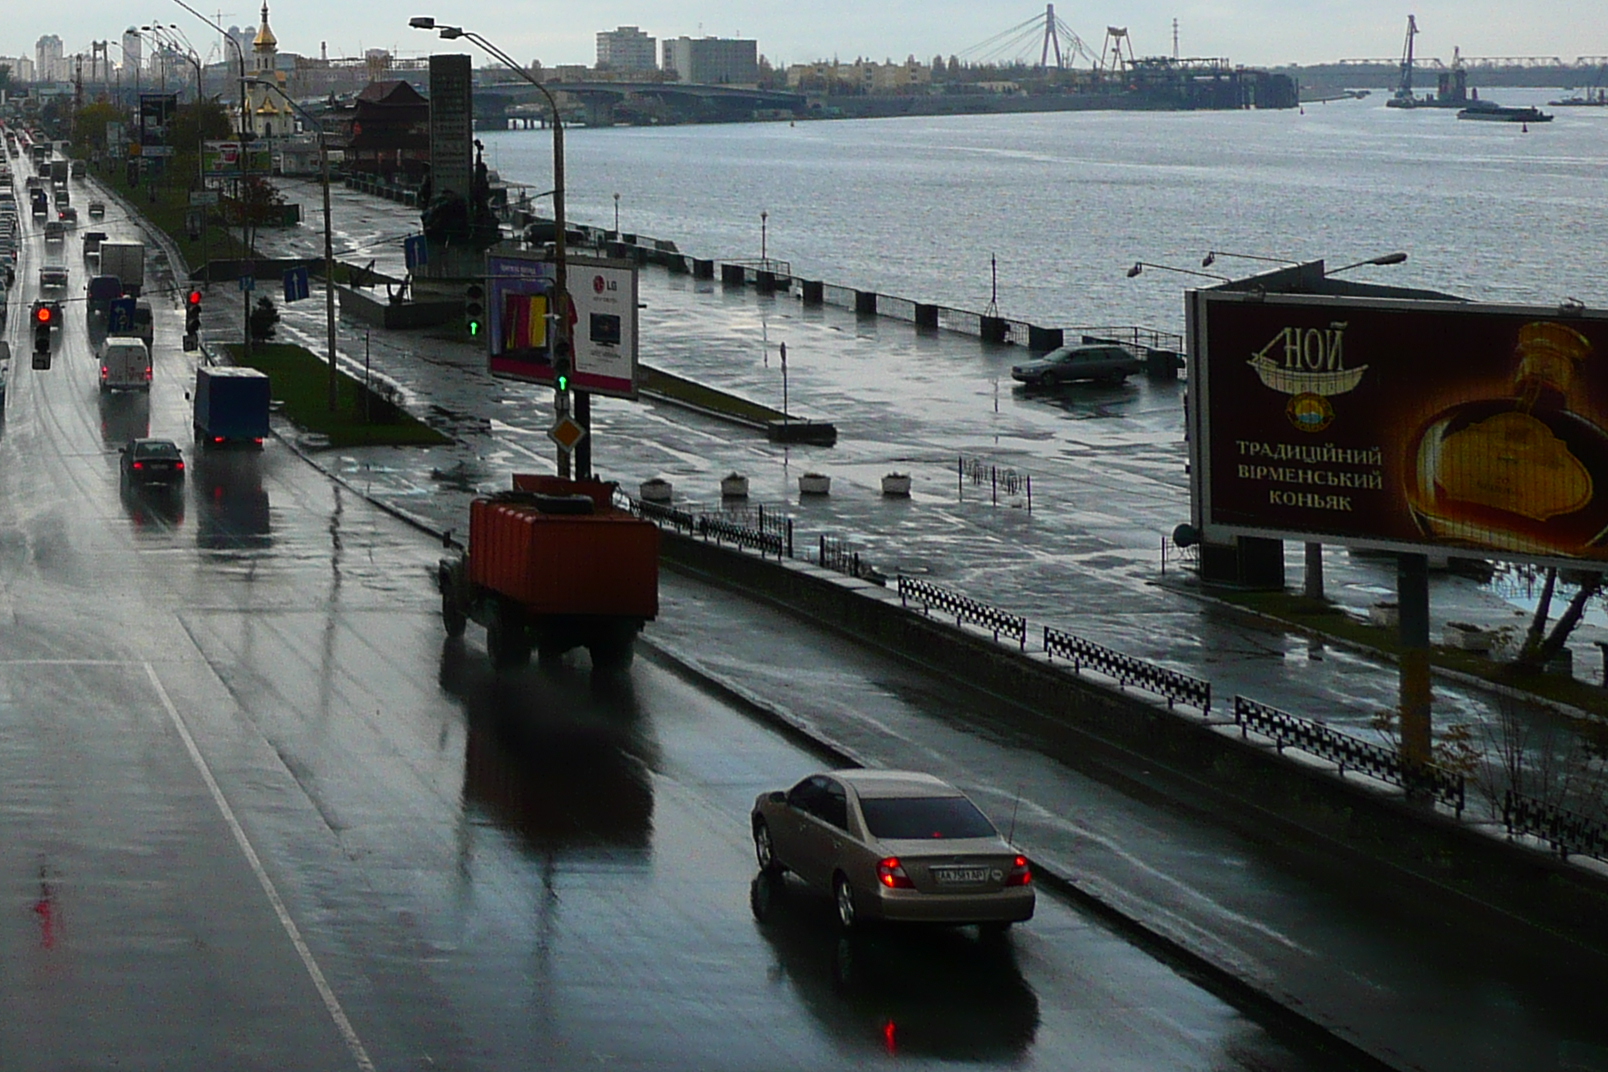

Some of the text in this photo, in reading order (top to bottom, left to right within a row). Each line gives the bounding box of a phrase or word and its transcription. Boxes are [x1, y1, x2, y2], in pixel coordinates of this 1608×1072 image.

[606, 280, 617, 291] LG
[1282, 320, 1349, 372] НОЙ
[1235, 439, 1383, 466] ТРАДИЦІЙНИЙ
[1237, 464, 1383, 491] ВІРМЕНСЬКИЙ
[1269, 490, 1353, 513] КОНЬЯК
